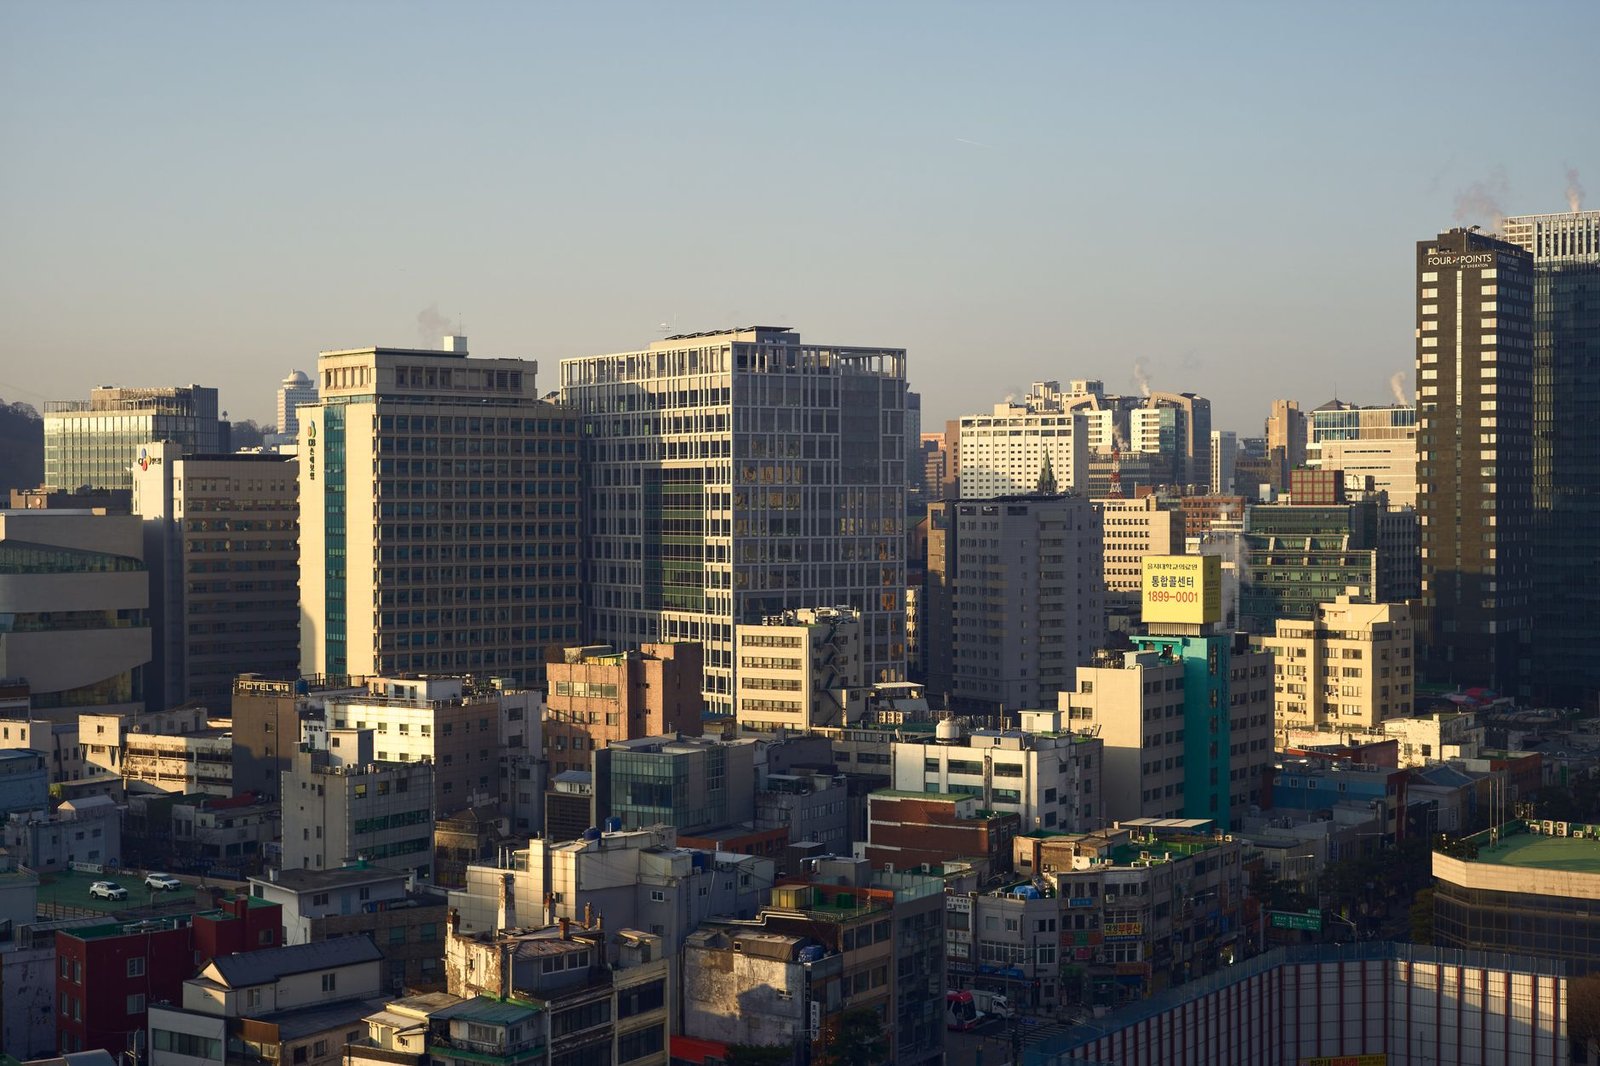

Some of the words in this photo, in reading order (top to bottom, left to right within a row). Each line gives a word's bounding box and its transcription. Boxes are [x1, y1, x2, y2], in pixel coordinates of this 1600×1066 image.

[1428, 257, 1452, 266] FOUR
[1460, 254, 1492, 264] POINTS
[1148, 591, 1198, 603] 1899-0001
[238, 680, 273, 691] HOTEL
